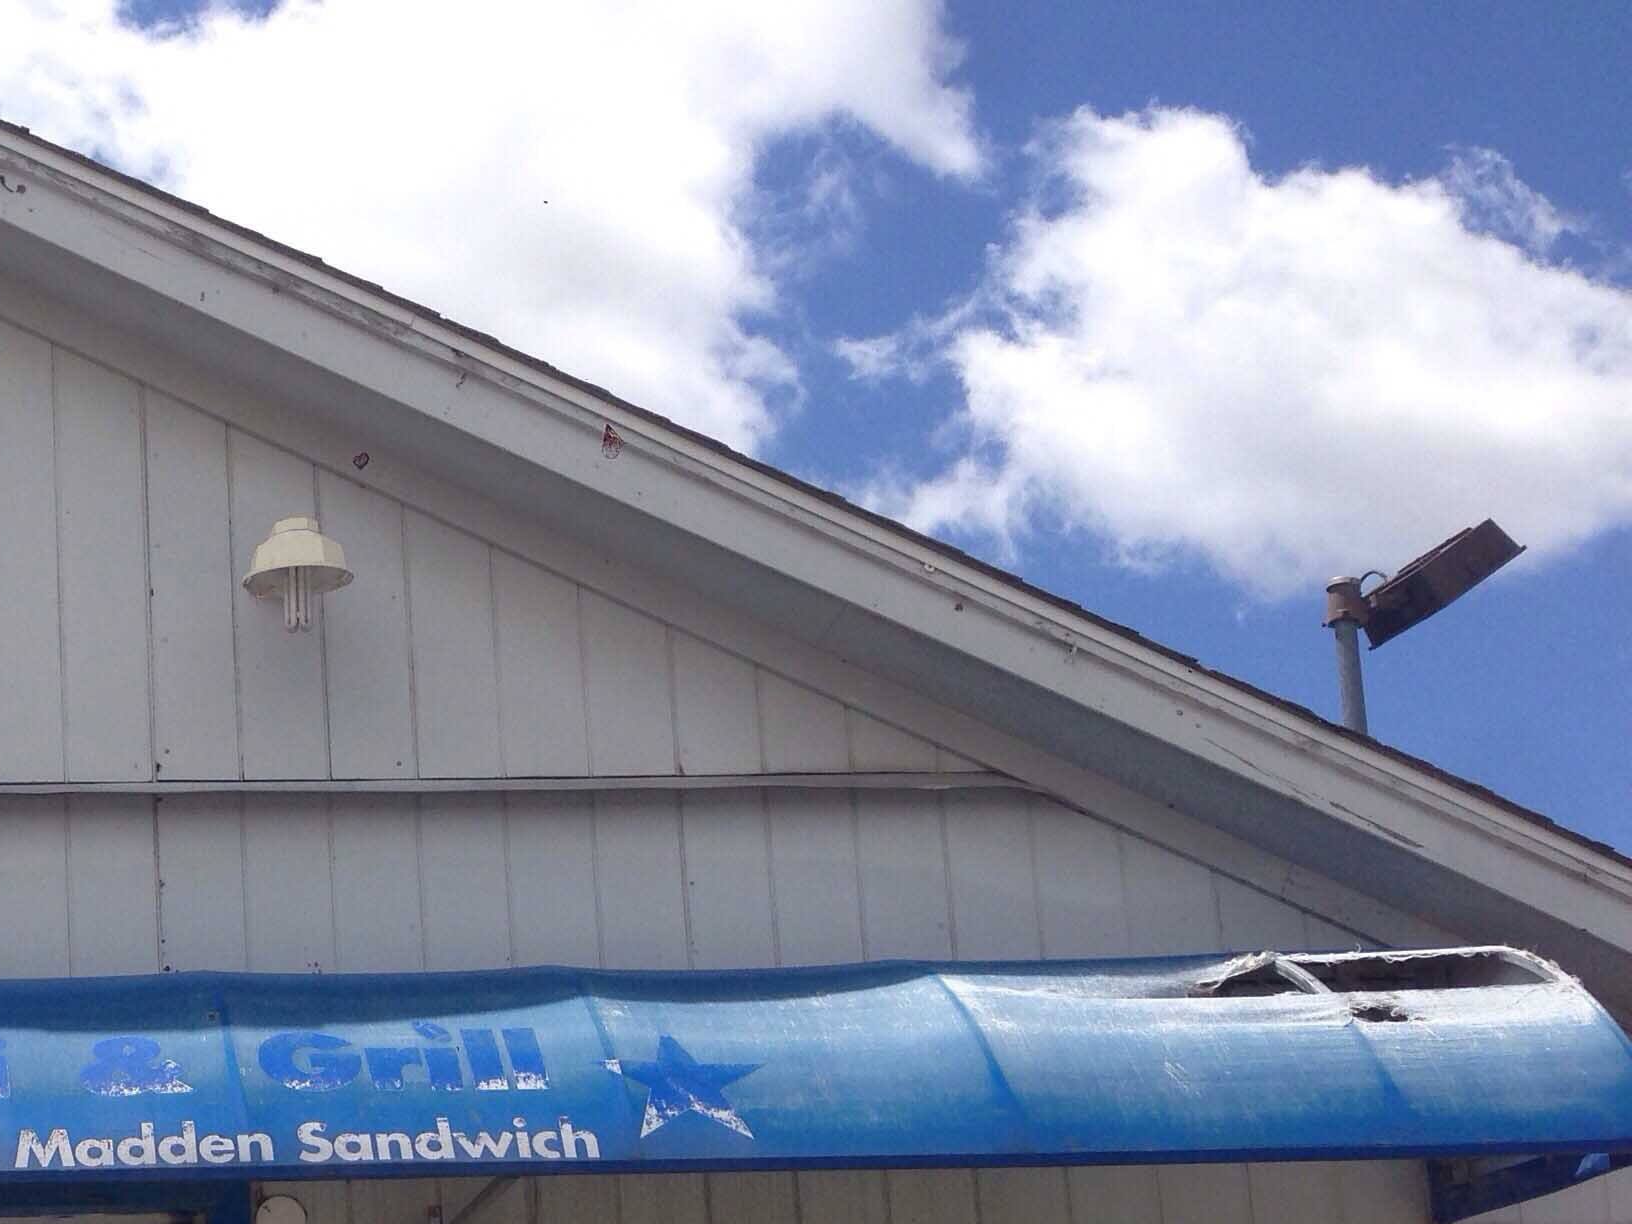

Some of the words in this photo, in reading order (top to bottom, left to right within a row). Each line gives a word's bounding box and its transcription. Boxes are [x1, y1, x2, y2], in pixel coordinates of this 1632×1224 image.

[79, 1036, 195, 1098] &
[258, 1018, 551, 1093] Grill
[14, 1120, 274, 1169] Madden
[297, 1116, 601, 1163] Sandwich
